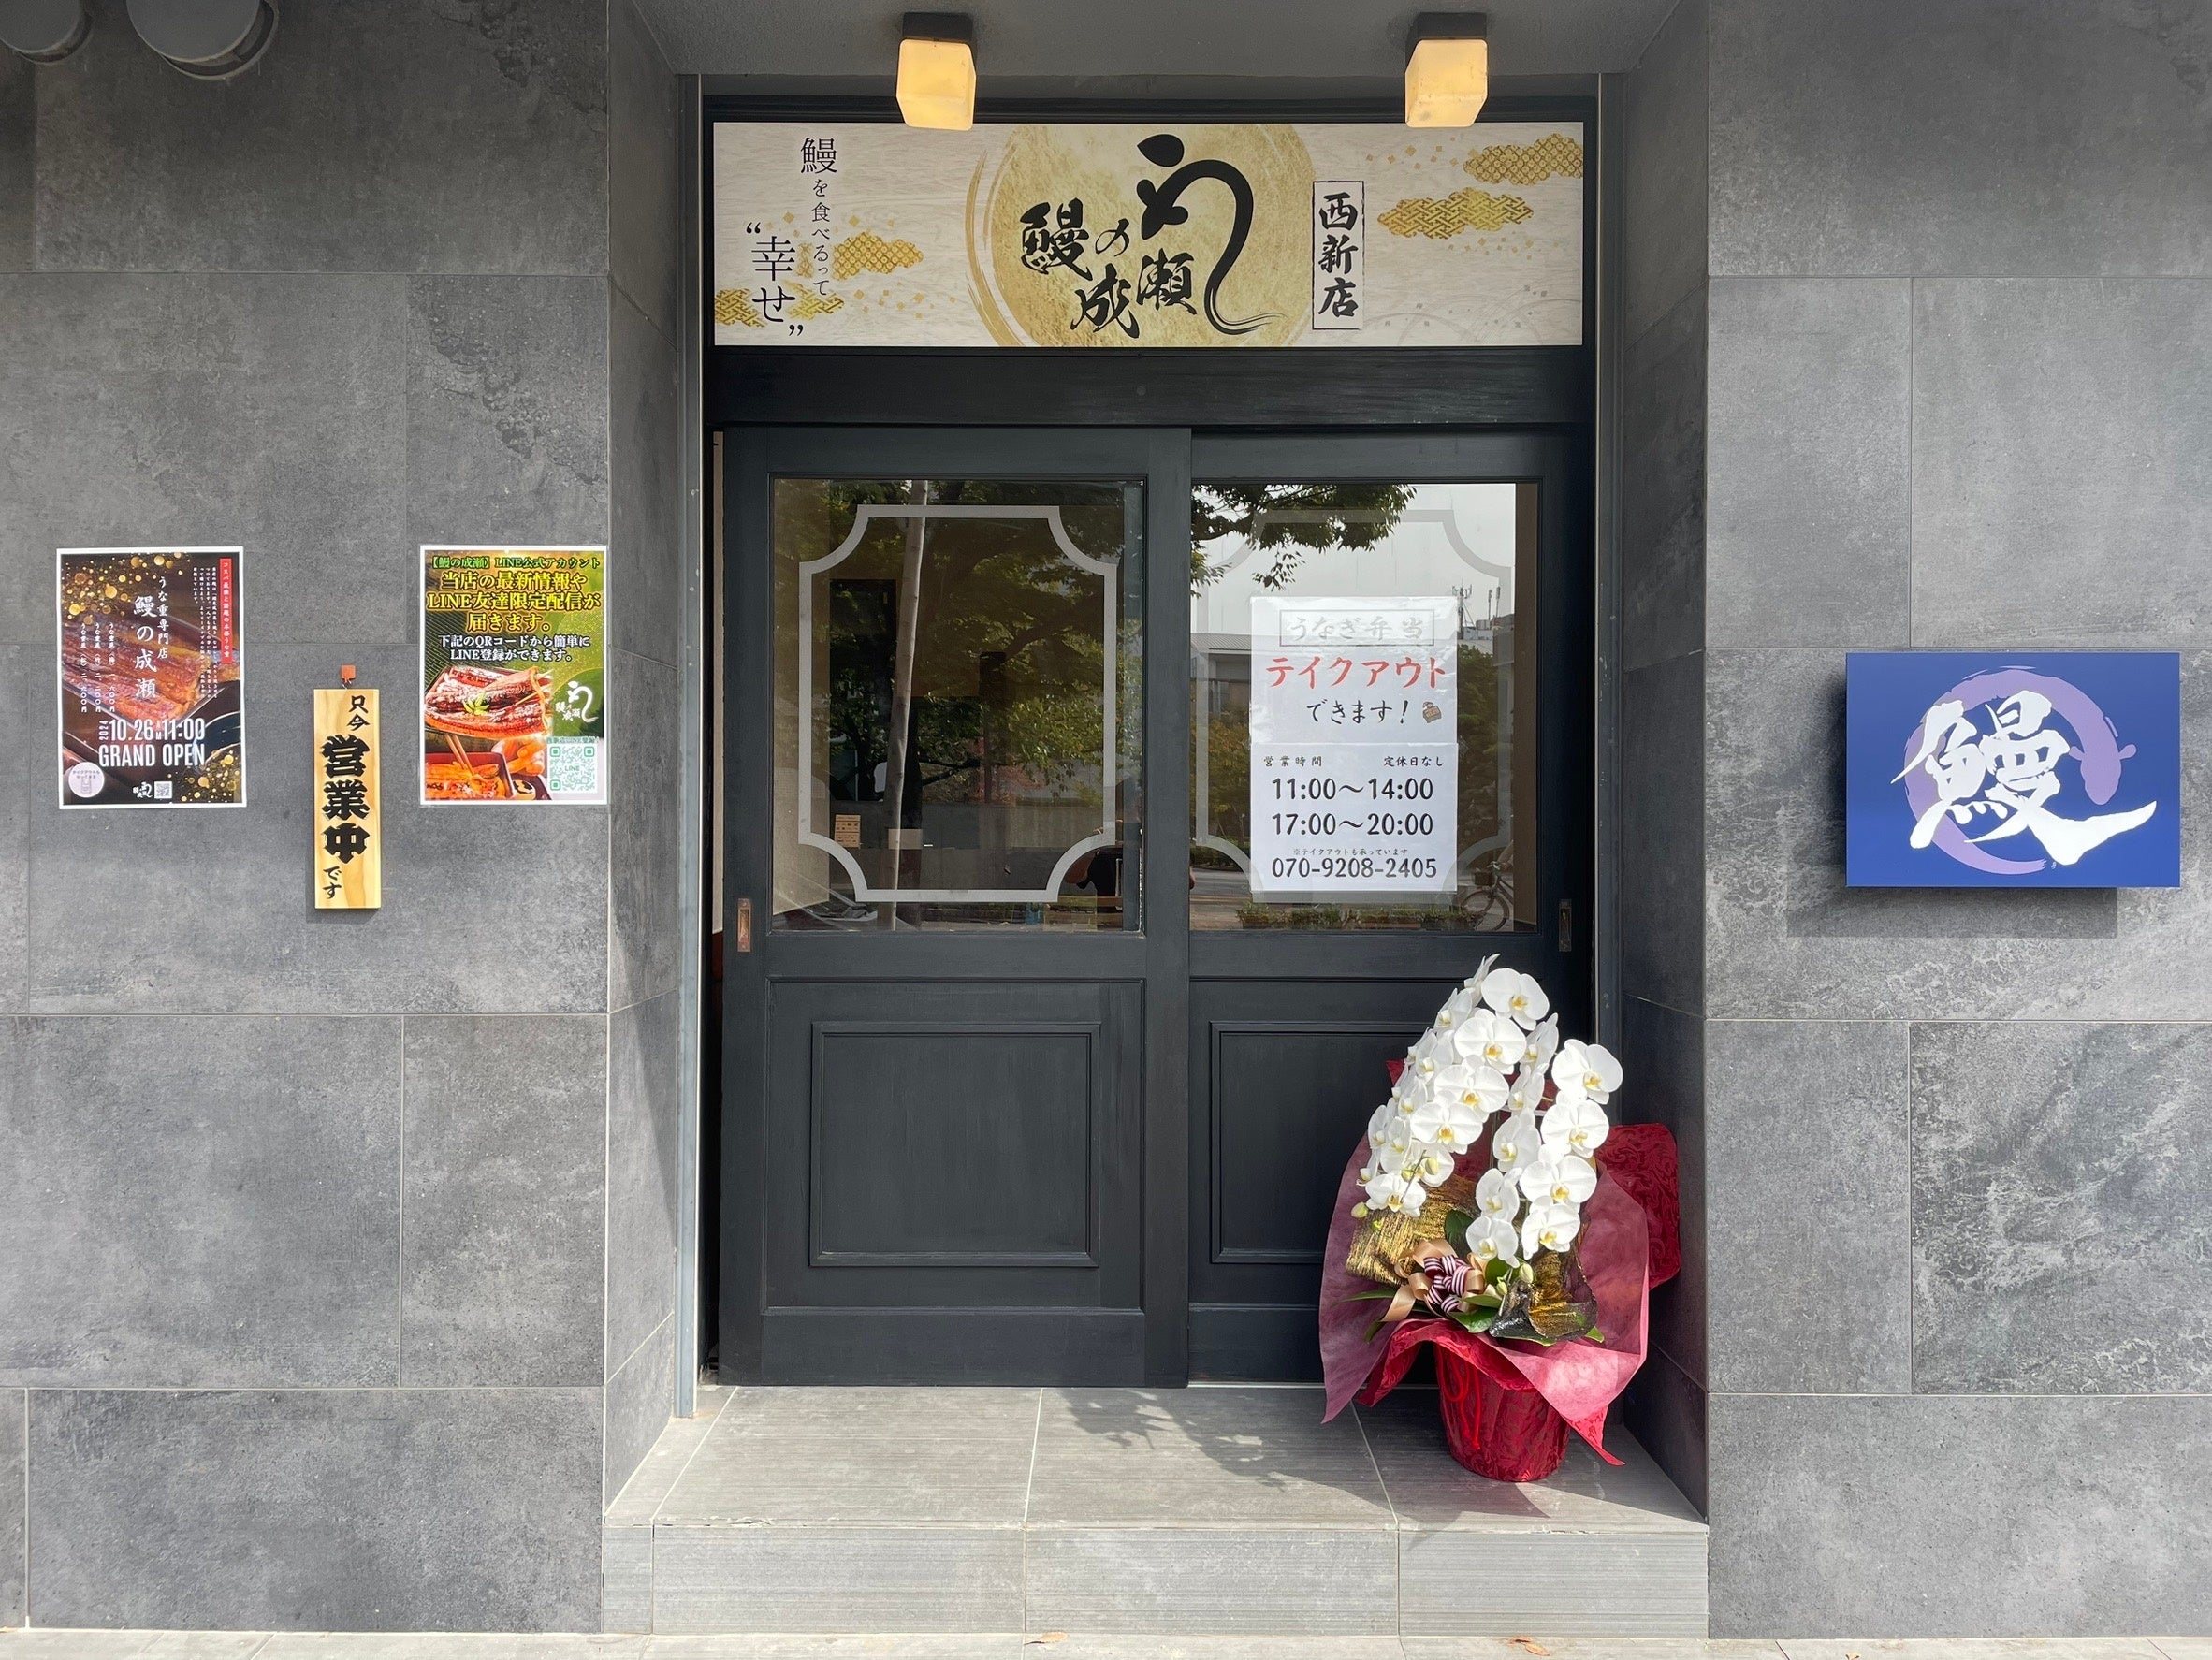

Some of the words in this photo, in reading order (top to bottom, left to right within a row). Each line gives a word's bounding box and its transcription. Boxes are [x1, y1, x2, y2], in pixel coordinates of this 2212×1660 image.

[1317, 191, 1360, 318] 西新店
[442, 571, 588, 590] 当店の最新情報や
[427, 591, 601, 610] LINE友達限定配信が
[157, 576, 170, 659] うな重専門店
[467, 613, 551, 633] 届きます。
[1290, 615, 1424, 642] うなぎ弁当
[134, 595, 158, 699] 鰻の成瀬
[440, 634, 590, 648] 下記のQRコードから簡単に
[450, 649, 572, 662] LINE登録ができます。
[1266, 656, 1446, 689] テイクアウト
[99, 720, 109, 741] 2024
[109, 718, 153, 741] 10.26
[163, 718, 206, 741] 11:00
[98, 744, 156, 767] GRAND
[162, 743, 206, 766] OPEN
[1263, 755, 1322, 767] 営業時間
[1383, 755, 1445, 767] 定休日なし
[1890, 690, 2157, 866] 鰻
[1272, 857, 1437, 878] 070-9208-2405
